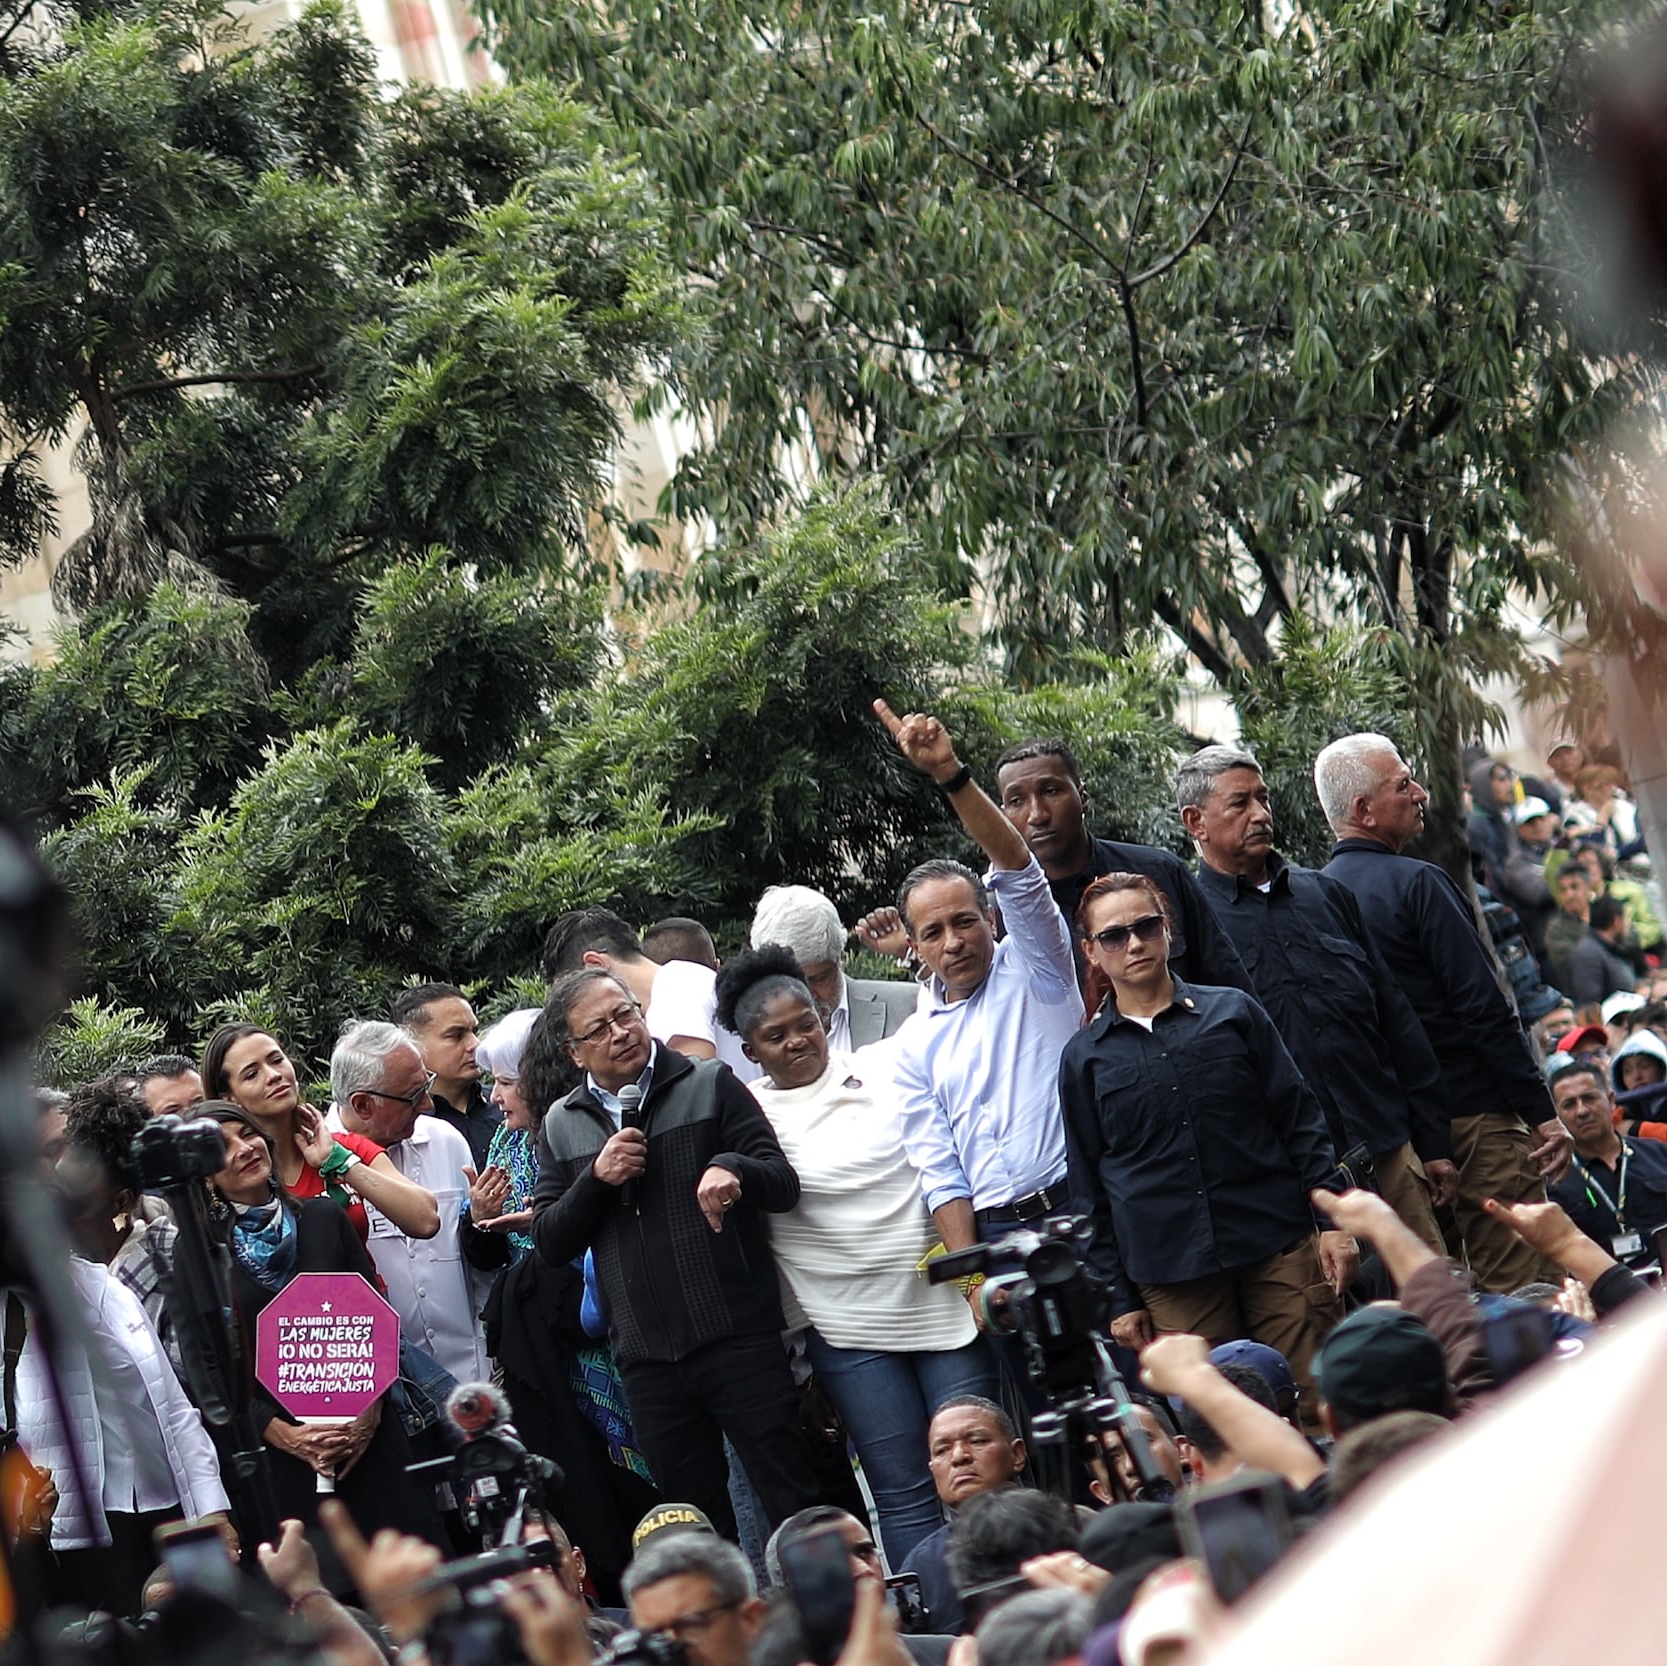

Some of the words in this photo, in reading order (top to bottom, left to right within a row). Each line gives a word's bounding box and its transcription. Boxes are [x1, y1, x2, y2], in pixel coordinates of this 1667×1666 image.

[278, 1317, 290, 1326] EL
[293, 1316, 333, 1326] CAMBIO
[336, 1316, 349, 1325] ES
[352, 1315, 374, 1325] CON
[280, 1327, 307, 1342] LAS
[310, 1326, 372, 1342] MUJERES
[299, 1343, 323, 1359] NO
[326, 1339, 374, 1358] SERÁ!
[278, 1359, 375, 1380] #TRANSICIÓN
[634, 1509, 701, 1547] POLICIA
